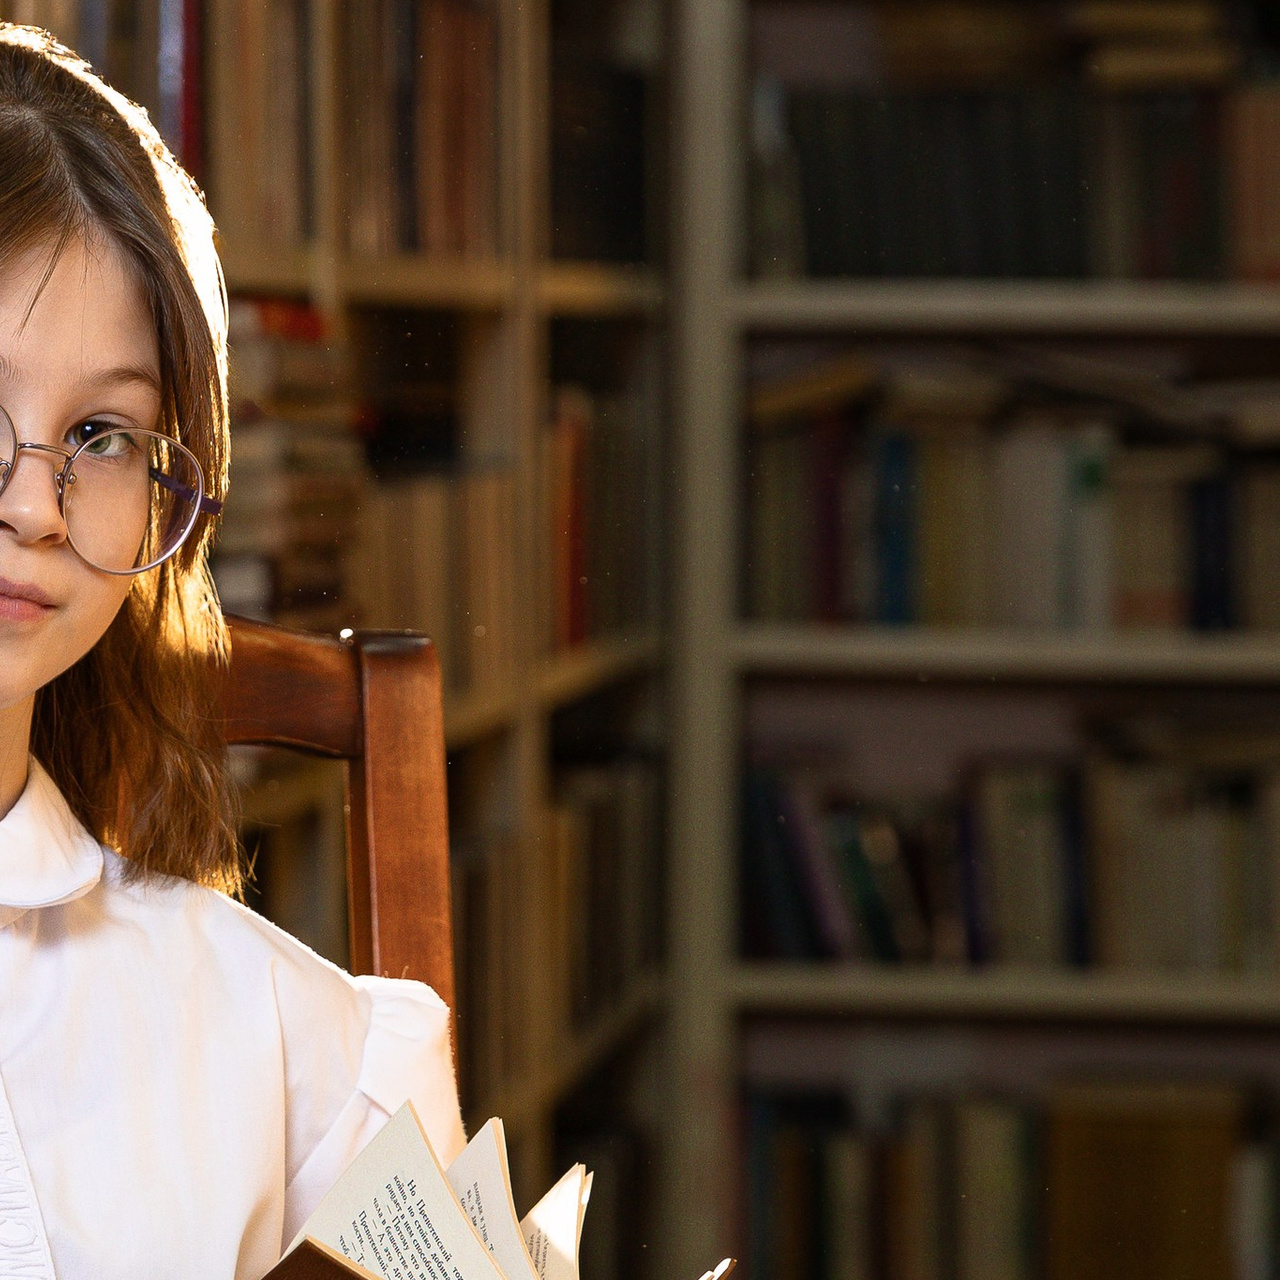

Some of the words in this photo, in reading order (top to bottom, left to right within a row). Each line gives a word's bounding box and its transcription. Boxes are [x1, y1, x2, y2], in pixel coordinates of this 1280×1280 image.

[373, 1197, 384, 1219] чала
[385, 1225, 410, 1271] бешенстве
[385, 1183, 403, 1213] рицает
[403, 1220, 415, 1238] нем
[391, 1215, 410, 1251] Потому
[410, 1253, 420, 1270] что
[393, 1175, 408, 1204] койно,
[407, 1205, 416, 1218] но
[414, 1219, 432, 1250] стойко
[407, 1179, 417, 1197] Но
[416, 1199, 453, 1263] Препотенский
[383, 1246, 393, 1263] это
